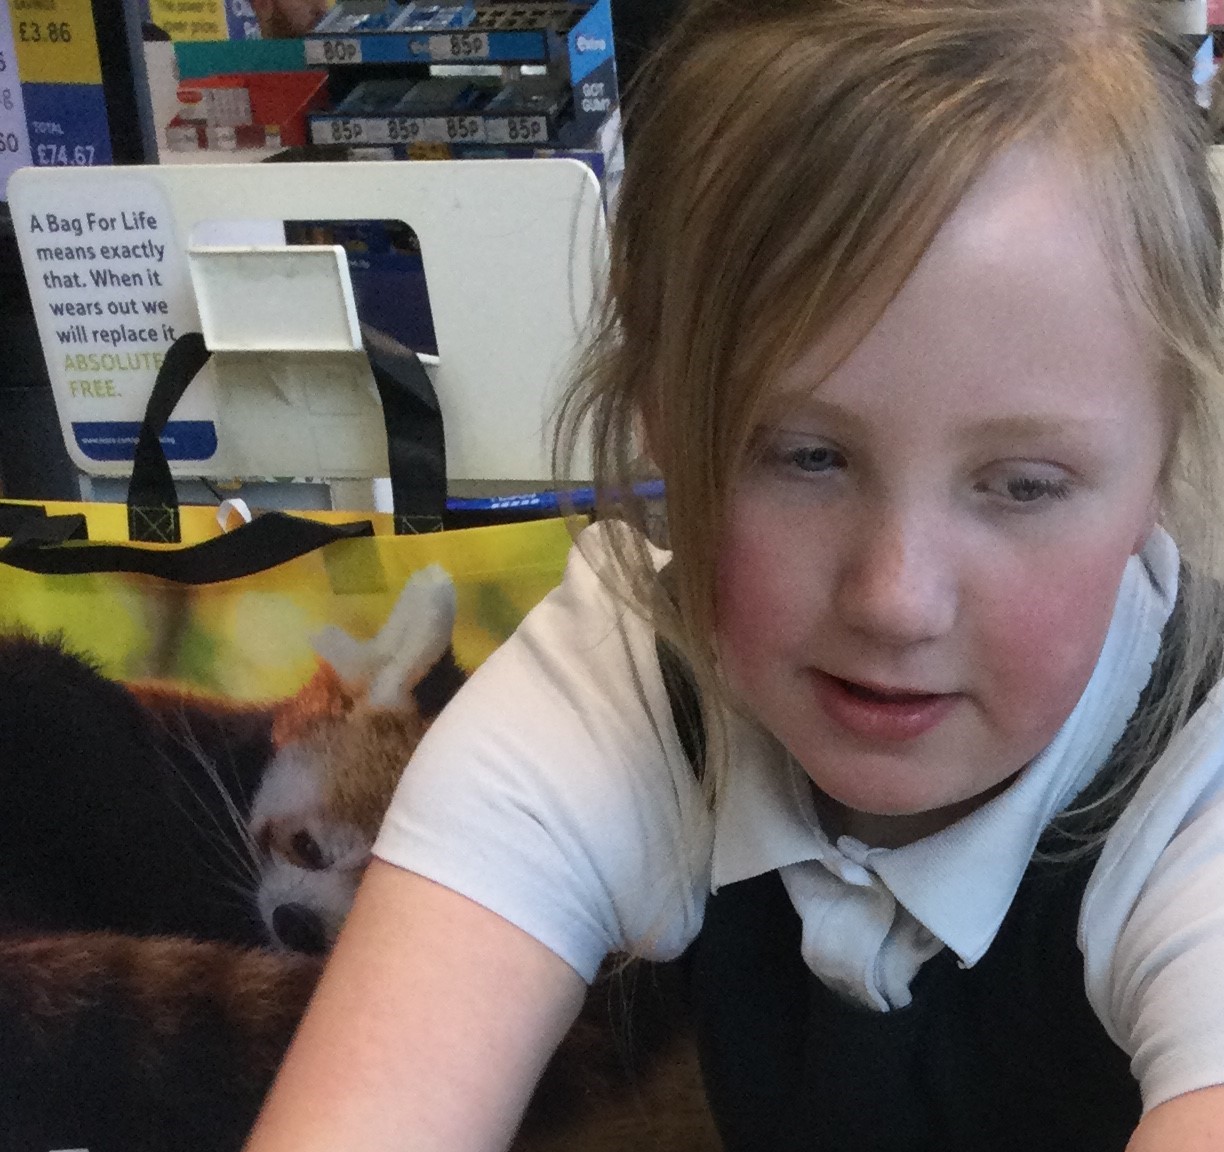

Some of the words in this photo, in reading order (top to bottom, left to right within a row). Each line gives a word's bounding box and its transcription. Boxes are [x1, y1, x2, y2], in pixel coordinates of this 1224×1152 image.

[323, 41, 356, 61] 80p
[450, 34, 483, 56] 85p
[331, 121, 362, 142] 85p
[387, 119, 419, 140] 85p
[447, 118, 479, 139] 85p
[508, 117, 541, 139] 85p
[37, 143, 95, 166] £74.67
[30, 214, 44, 233] A
[46, 213, 82, 237] Bag
[86, 212, 117, 232] For
[121, 211, 158, 231] Life
[36, 246, 96, 262] means
[101, 239, 165, 262] exactly
[43, 270, 87, 289] that.
[89, 269, 144, 288] When
[147, 268, 163, 287] it
[49, 301, 103, 317] wears
[107, 299, 139, 315] out
[142, 300, 169, 315] we
[56, 325, 87, 345] will
[92, 324, 159, 347] replace
[161, 324, 176, 342] it
[65, 351, 166, 372] ABSOLUTE
[69, 379, 123, 398] FREE.
